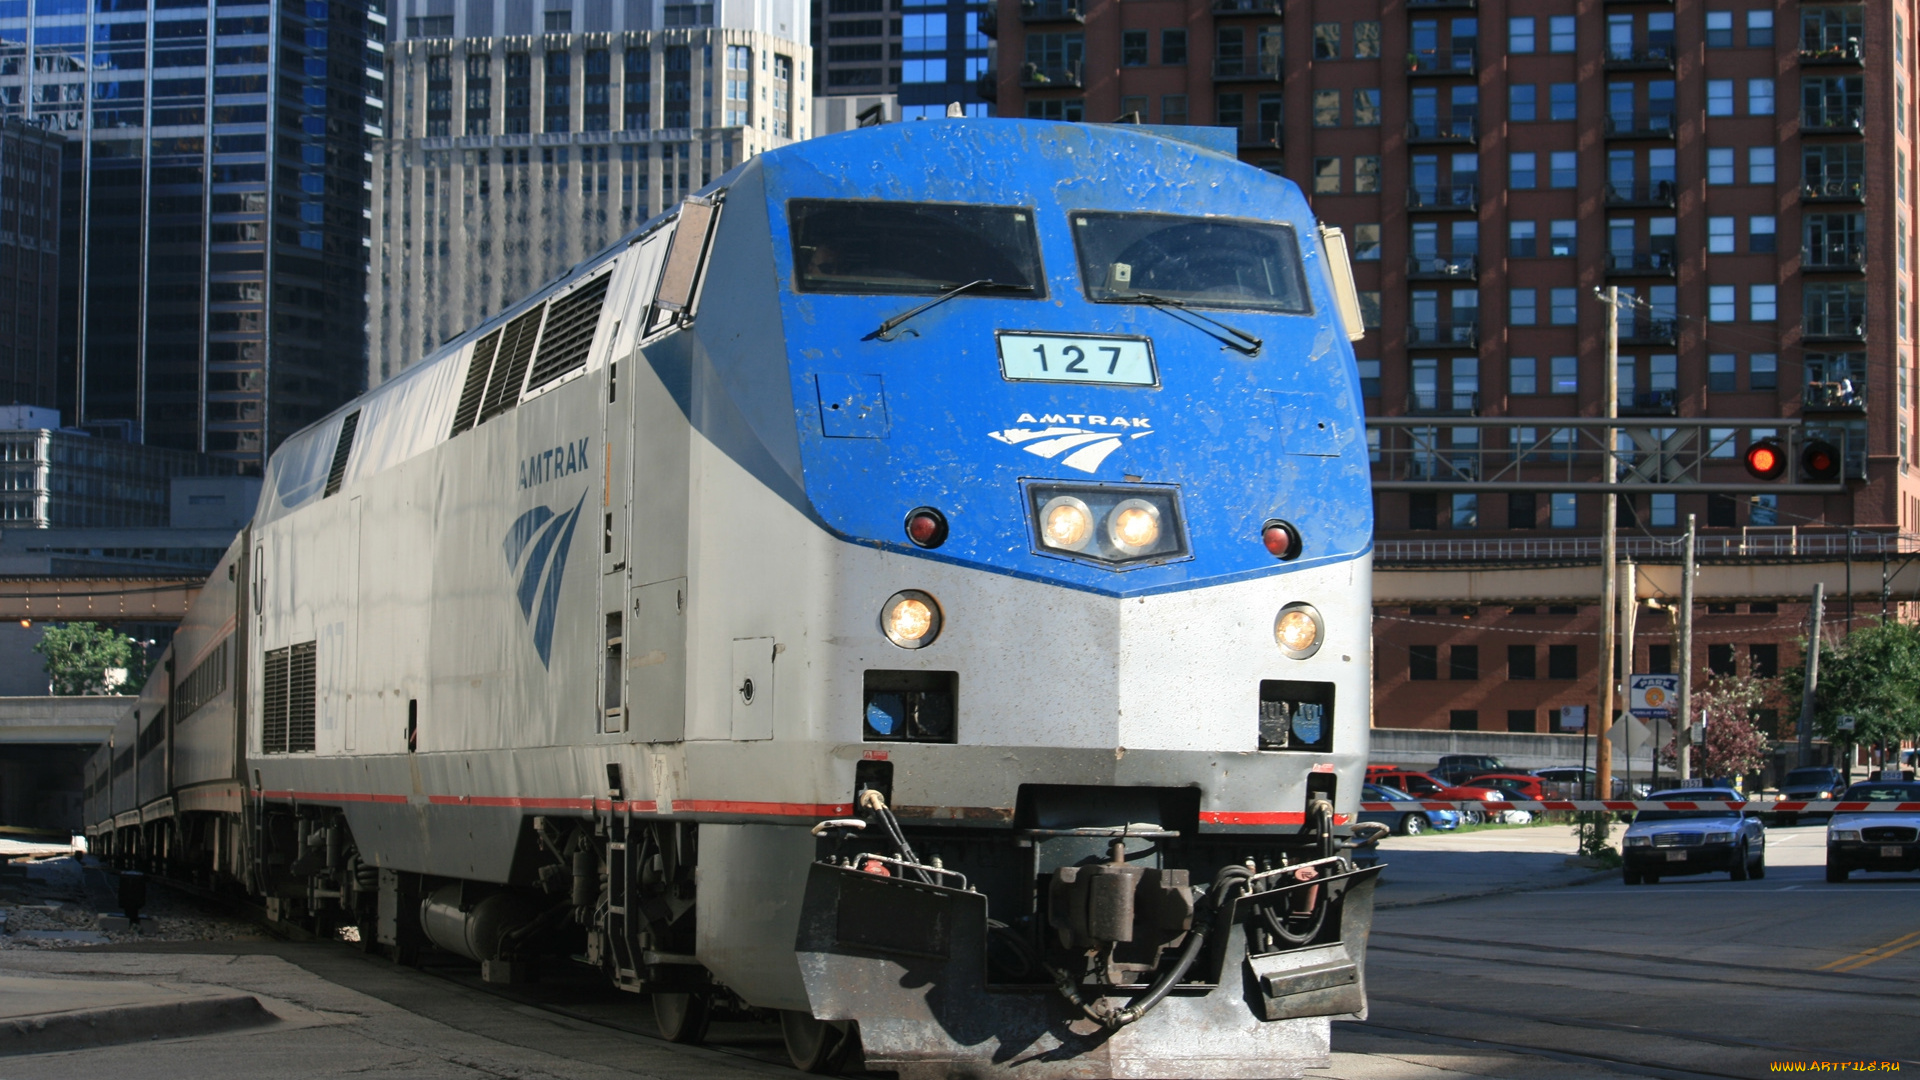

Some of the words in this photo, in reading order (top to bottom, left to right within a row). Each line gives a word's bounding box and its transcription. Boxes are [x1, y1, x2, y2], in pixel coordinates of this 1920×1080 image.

[1033, 343, 1122, 375] 127
[1016, 413, 1151, 428] AMTRAK
[517, 436, 589, 491] AMTRAK
[321, 621, 344, 730] 127
[1640, 679, 1671, 688] PARK
